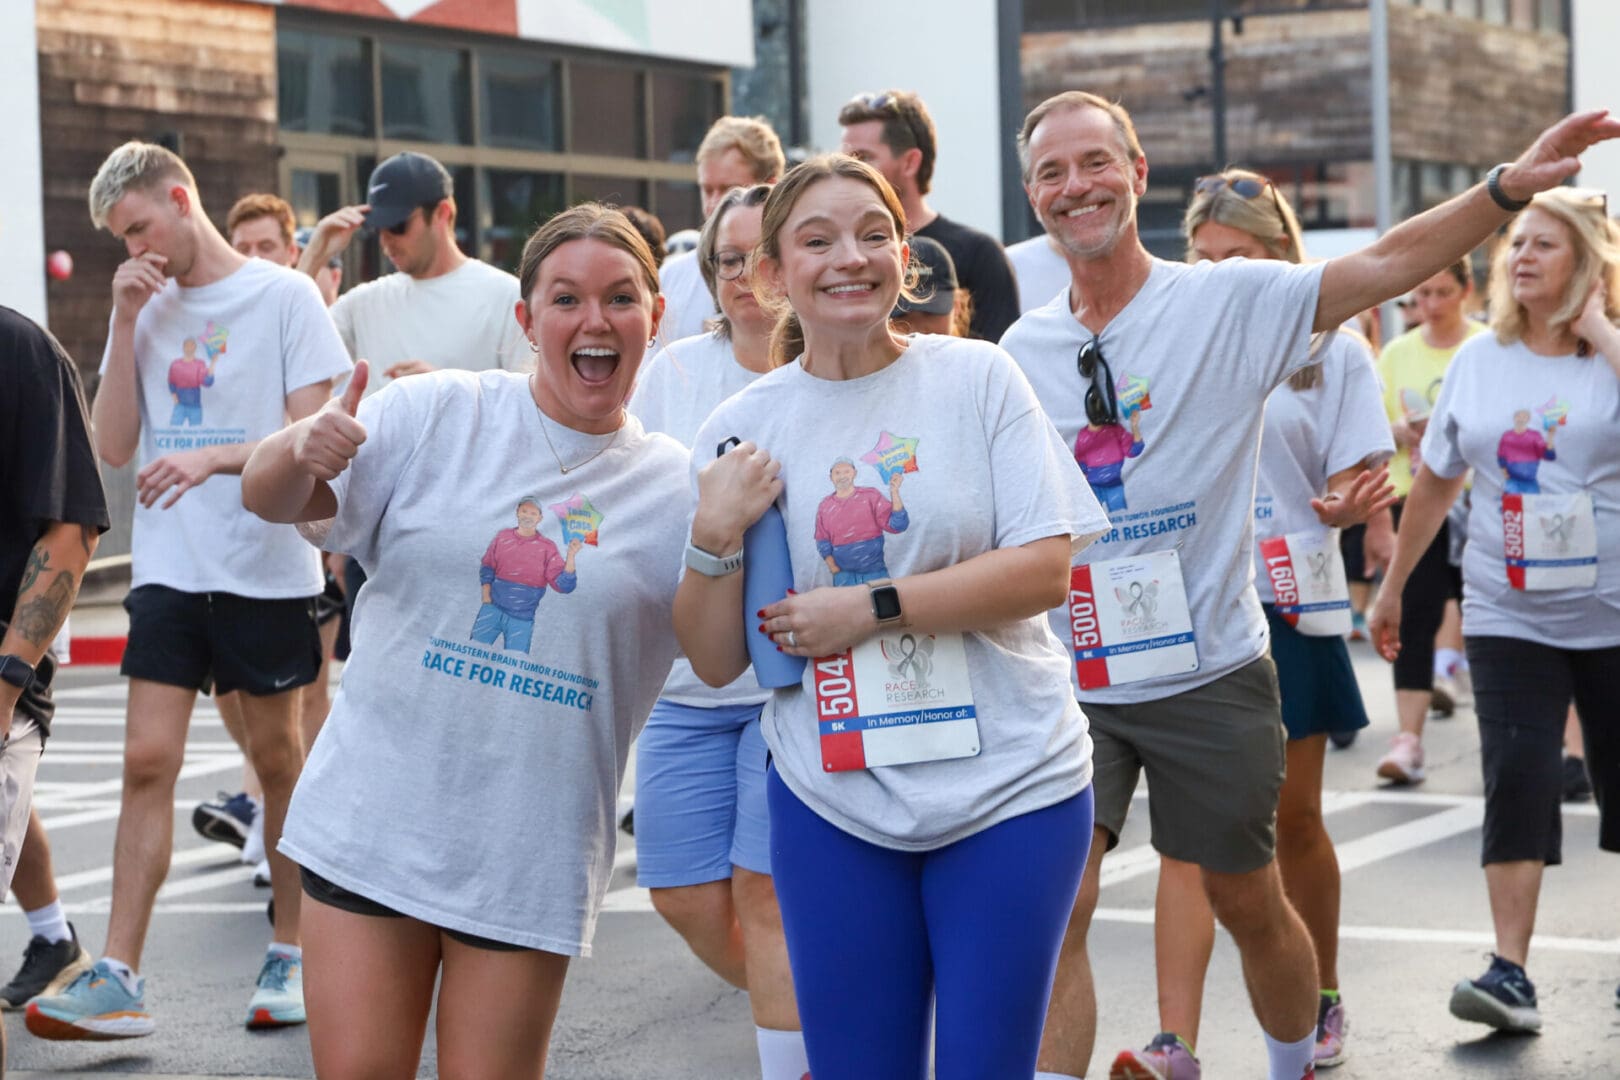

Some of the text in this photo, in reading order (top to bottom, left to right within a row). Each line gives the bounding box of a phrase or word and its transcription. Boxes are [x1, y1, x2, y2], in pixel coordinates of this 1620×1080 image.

[174, 438, 193, 448] FOR
[1151, 501, 1196, 517] FOUNDATION
[1123, 512, 1196, 541] RESEARCH
[1504, 510, 1522, 557] 5092
[1266, 556, 1297, 603] 5091
[1070, 590, 1099, 647] 5007
[430, 637, 489, 660] UTHEASTERN
[491, 653, 518, 667] BRAIN
[518, 660, 551, 676] TUMOR
[421, 650, 593, 712] RACE FOR RESEARCH
[817, 656, 854, 716] 504
[885, 680, 915, 692] RACE
[886, 688, 945, 702] RESEARCH
[831, 721, 846, 731] 5K
[867, 718, 877, 728] In
[880, 709, 953, 726] Memory/Honor
